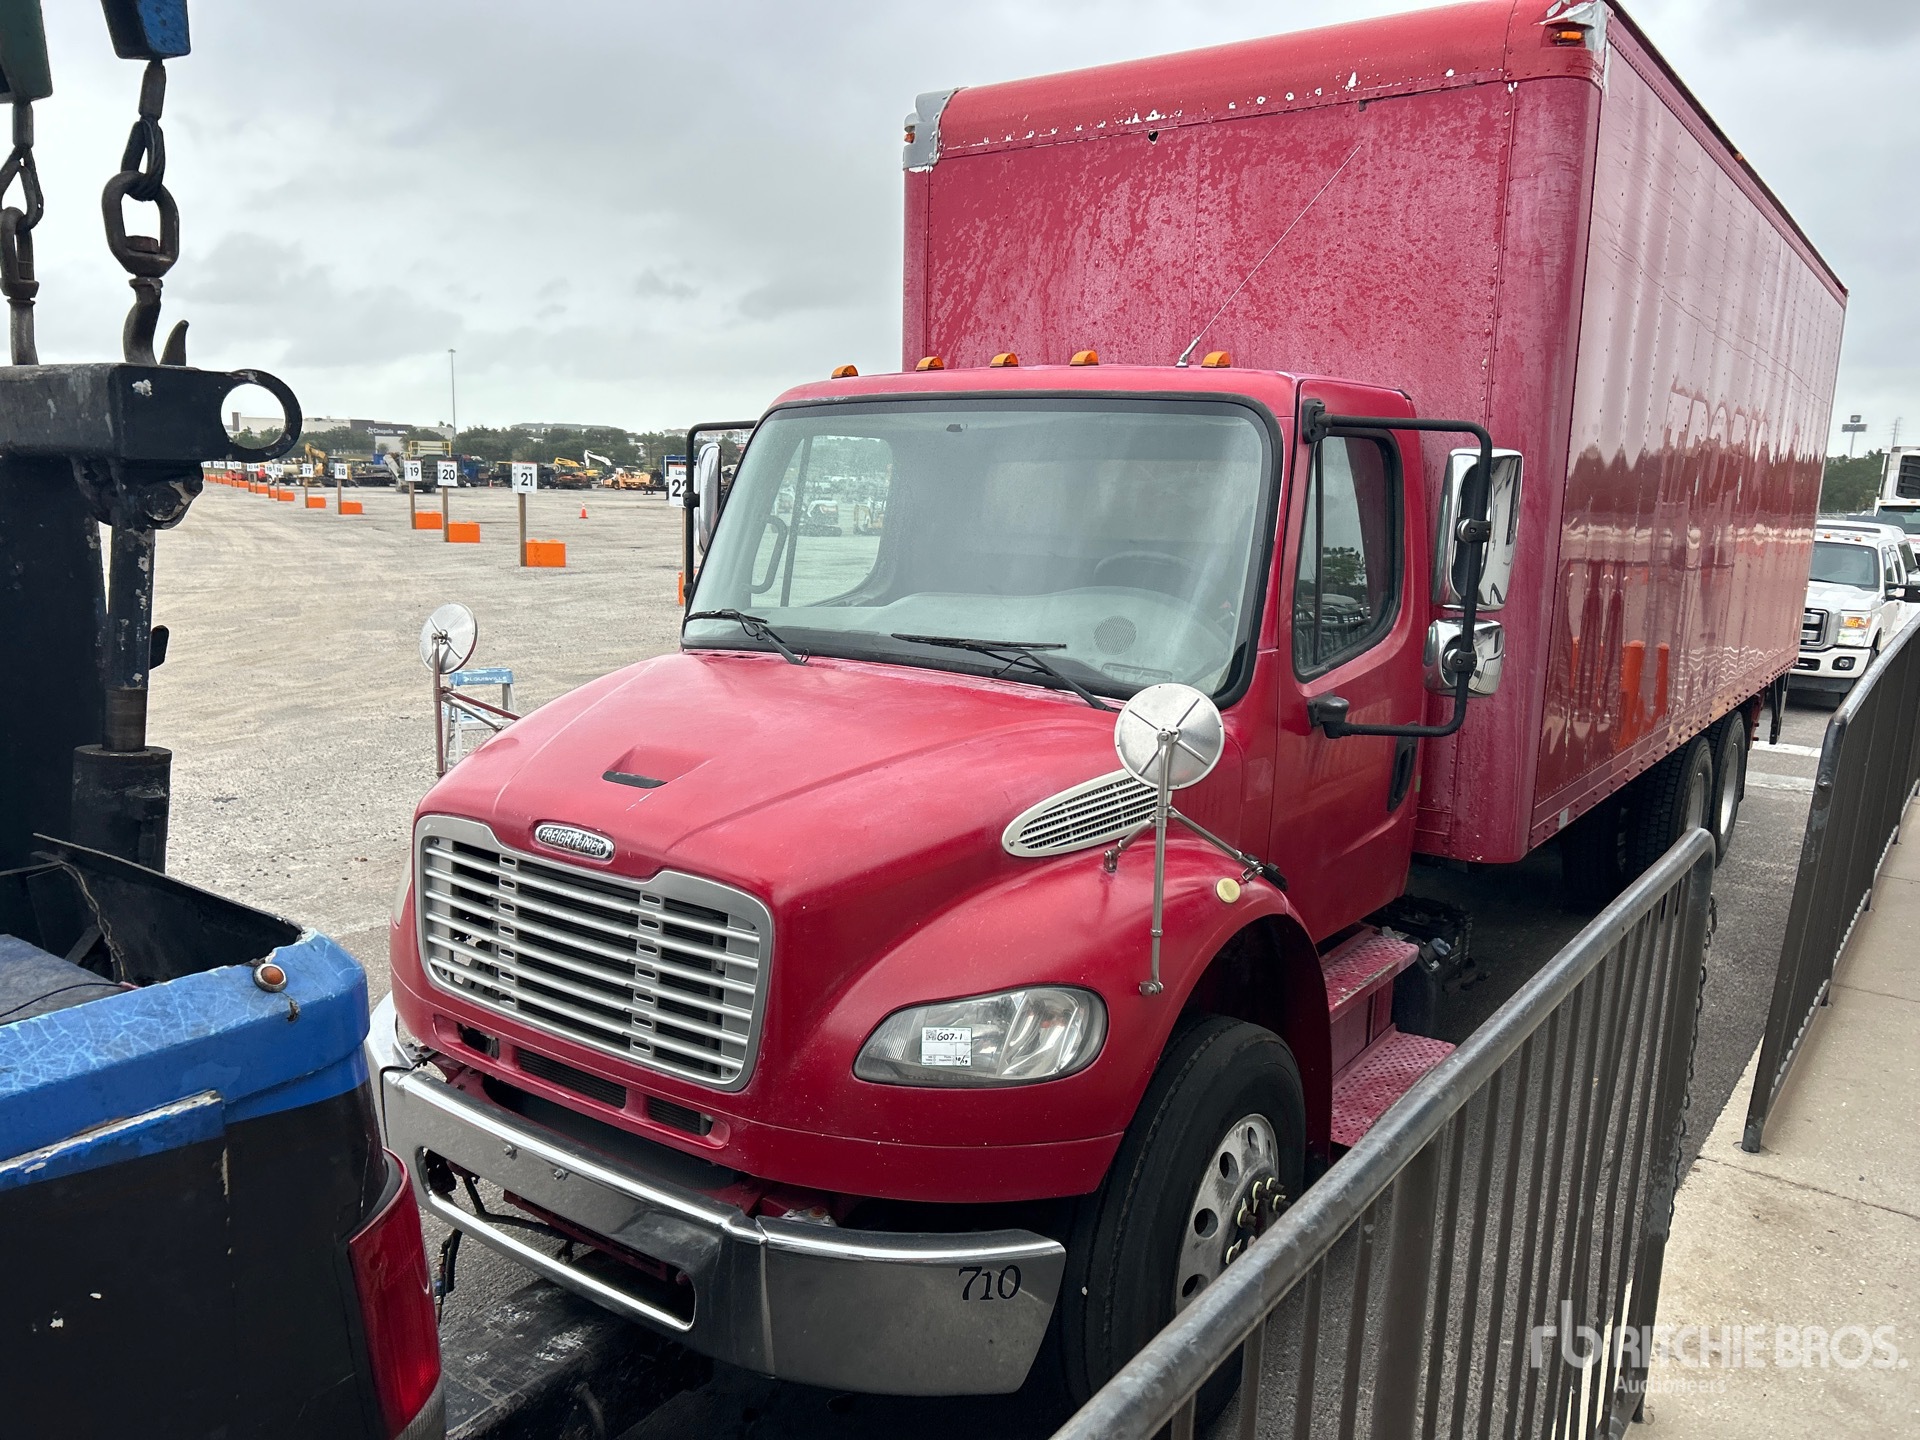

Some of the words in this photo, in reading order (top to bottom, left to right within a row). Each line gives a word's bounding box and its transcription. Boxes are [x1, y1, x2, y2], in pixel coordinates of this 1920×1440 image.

[338, 468, 346, 476] 18
[409, 467, 420, 477] 19
[442, 469, 456, 480] 20
[520, 472, 533, 487] 21
[541, 828, 604, 855] FREIGHTLINER
[959, 1265, 1021, 1301] 710
